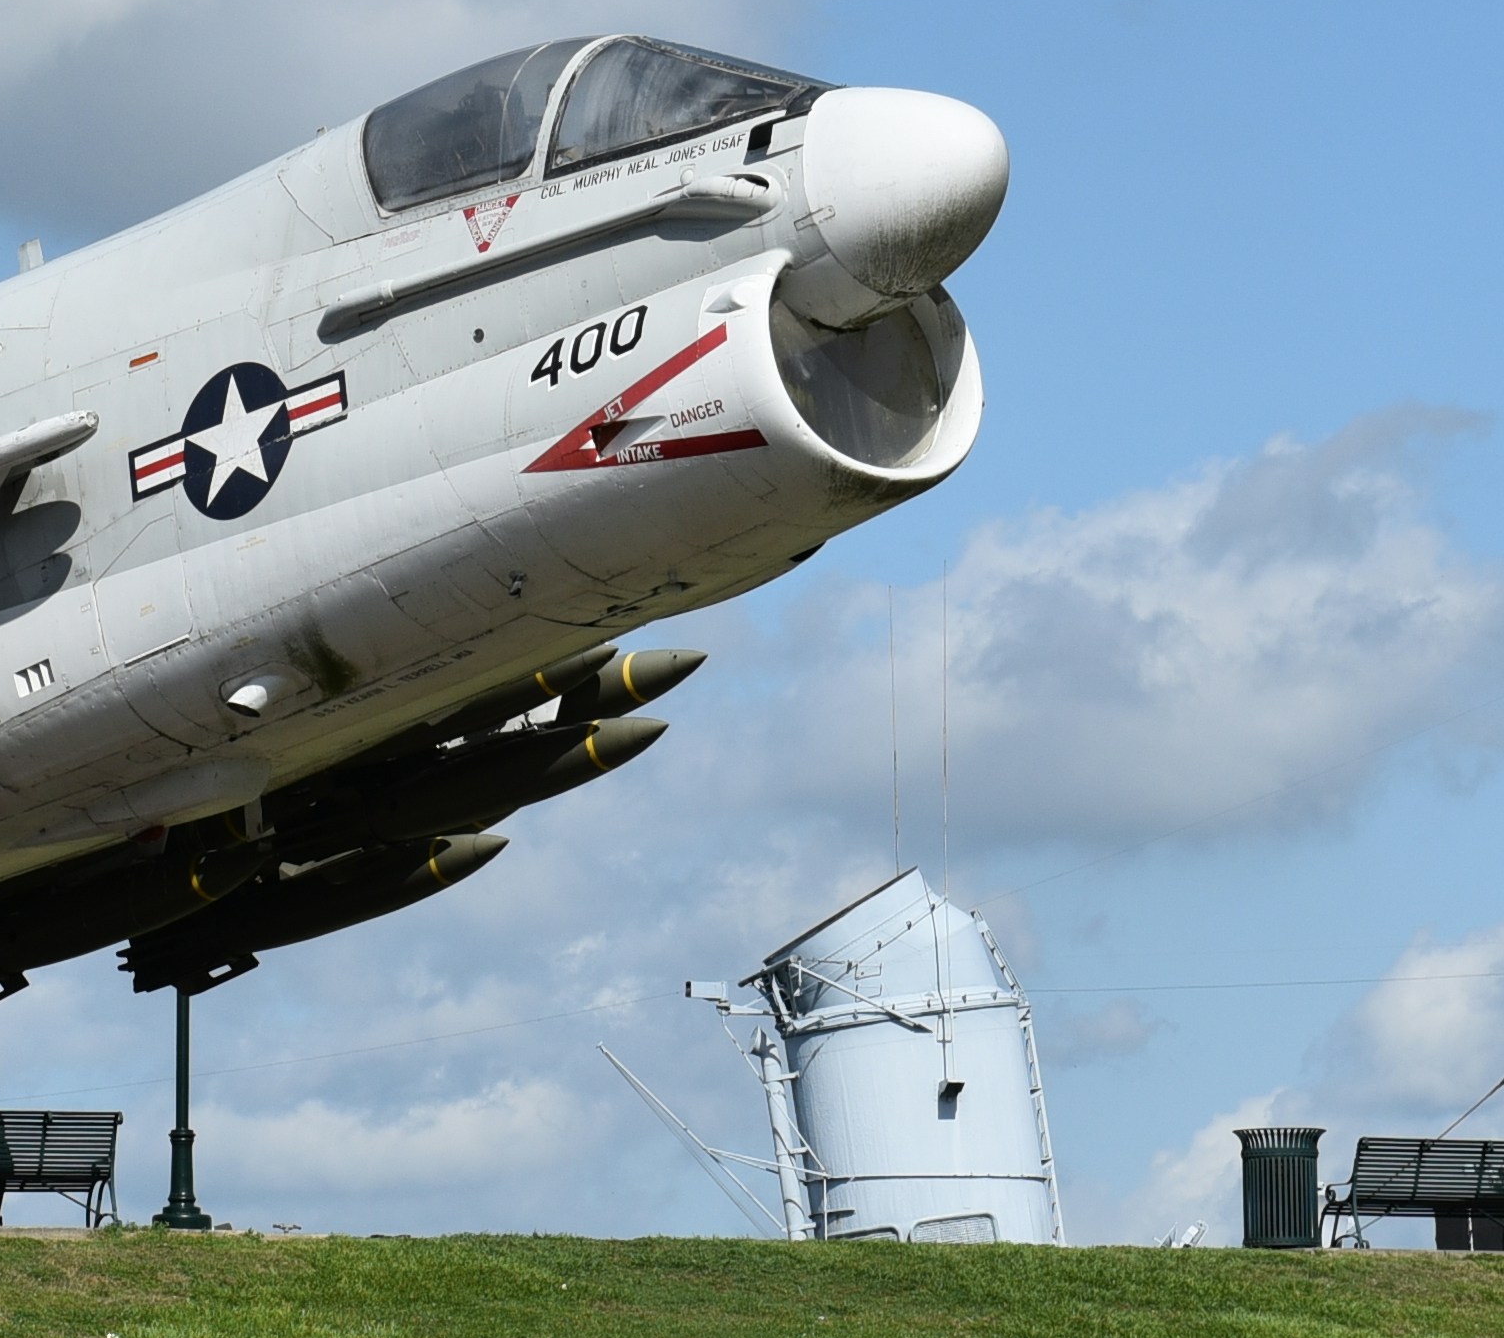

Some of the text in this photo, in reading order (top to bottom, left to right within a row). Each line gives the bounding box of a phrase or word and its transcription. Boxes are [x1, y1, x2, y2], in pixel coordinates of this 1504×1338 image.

[540, 133, 746, 200] COL. MURPHY NEAL JONES USAF
[529, 304, 648, 389] 400
[602, 396, 624, 423] JET
[669, 399, 725, 428] DANGER
[616, 443, 664, 464] INTAKE
